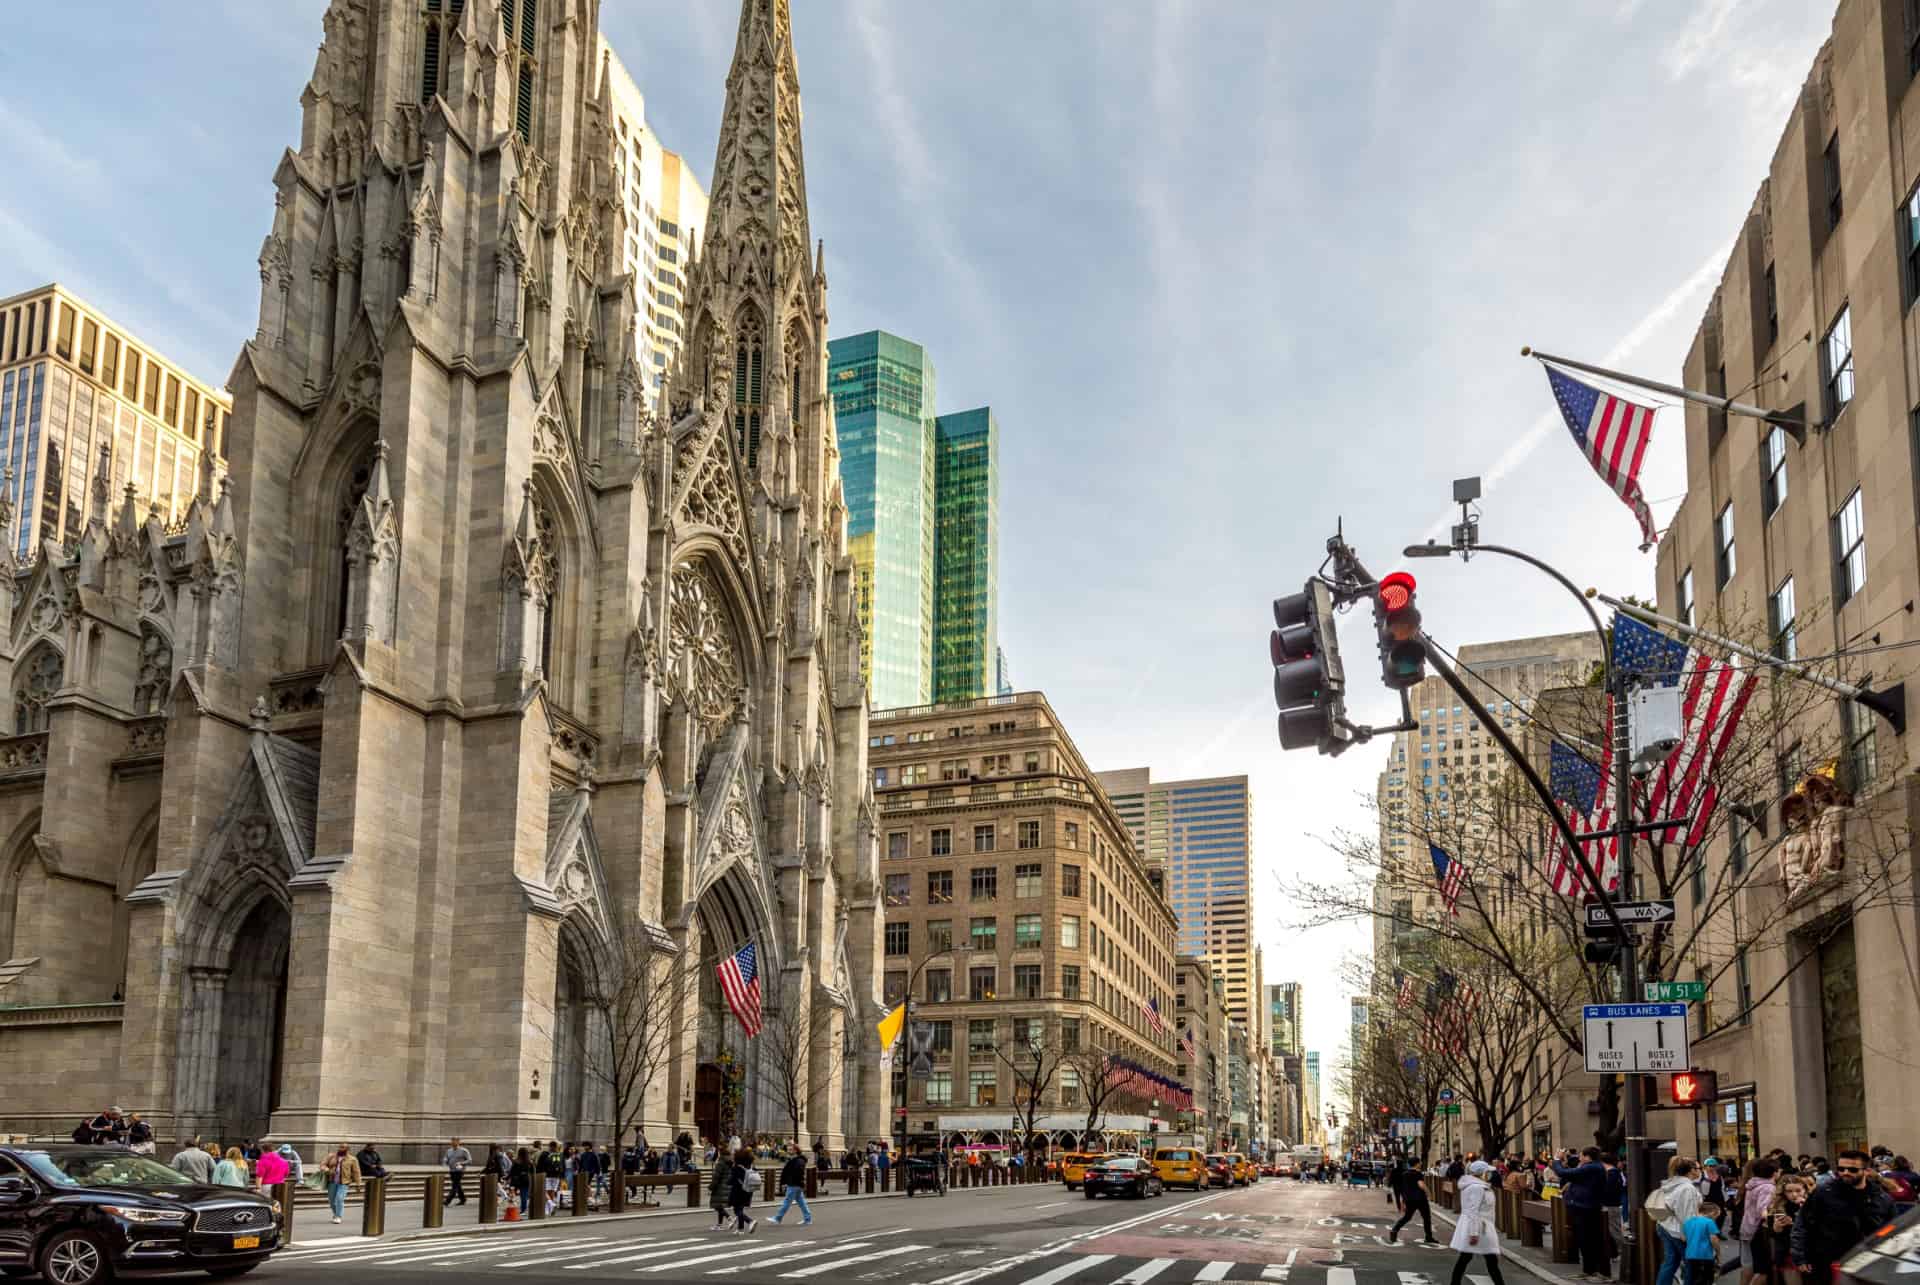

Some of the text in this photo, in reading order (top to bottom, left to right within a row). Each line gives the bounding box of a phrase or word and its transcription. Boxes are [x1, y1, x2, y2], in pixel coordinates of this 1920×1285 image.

[1633, 907, 1664, 918] WAY
[1660, 984, 1671, 998] W
[1676, 984, 1689, 998] 51
[1607, 1006, 1661, 1016] BUS LANES
[1598, 1051, 1624, 1060] BUSES
[1648, 1050, 1674, 1059] BUSES
[1600, 1061, 1622, 1069] ONLY
[1650, 1060, 1673, 1069] ONLY
